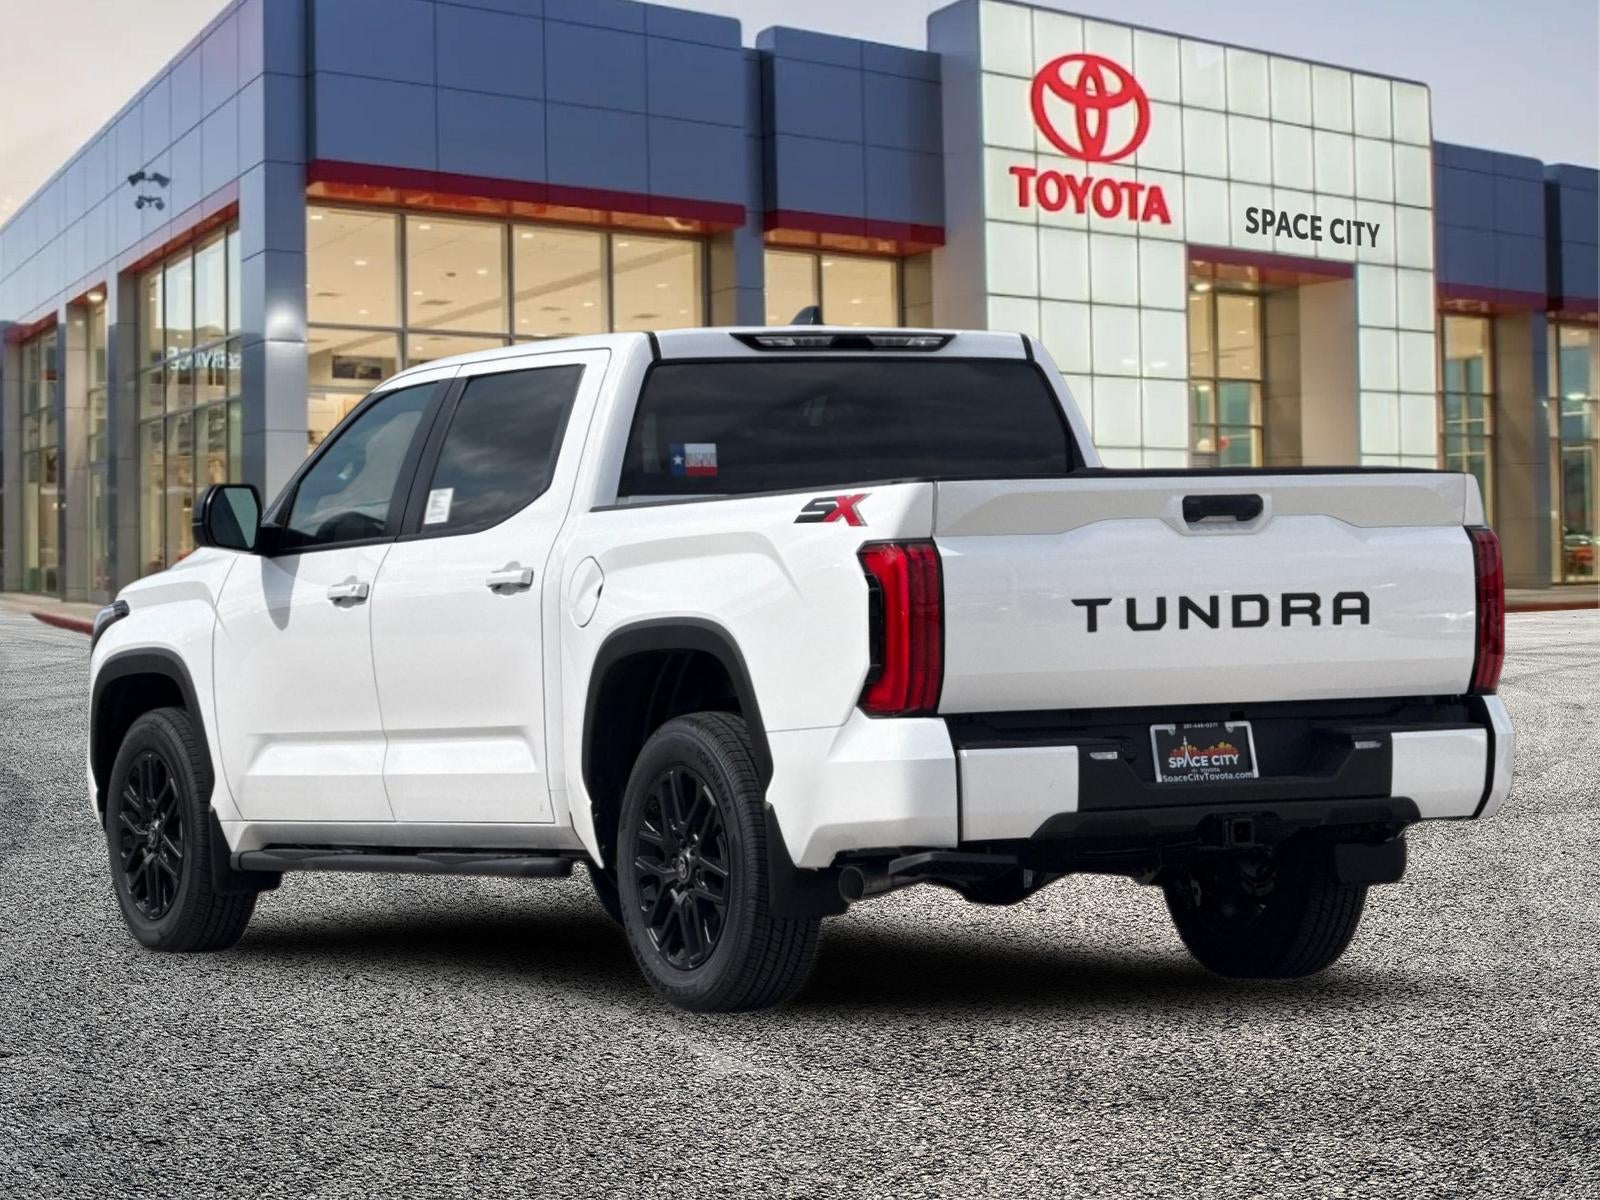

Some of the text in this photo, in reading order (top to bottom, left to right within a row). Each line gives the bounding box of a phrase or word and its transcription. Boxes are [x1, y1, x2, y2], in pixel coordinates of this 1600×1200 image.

[1009, 166, 1171, 224] TOYOTA
[1245, 206, 1381, 248] SPACE CITY
[1071, 591, 1370, 632] TUNDRA
[1168, 754, 1239, 768] SPACE CITY
